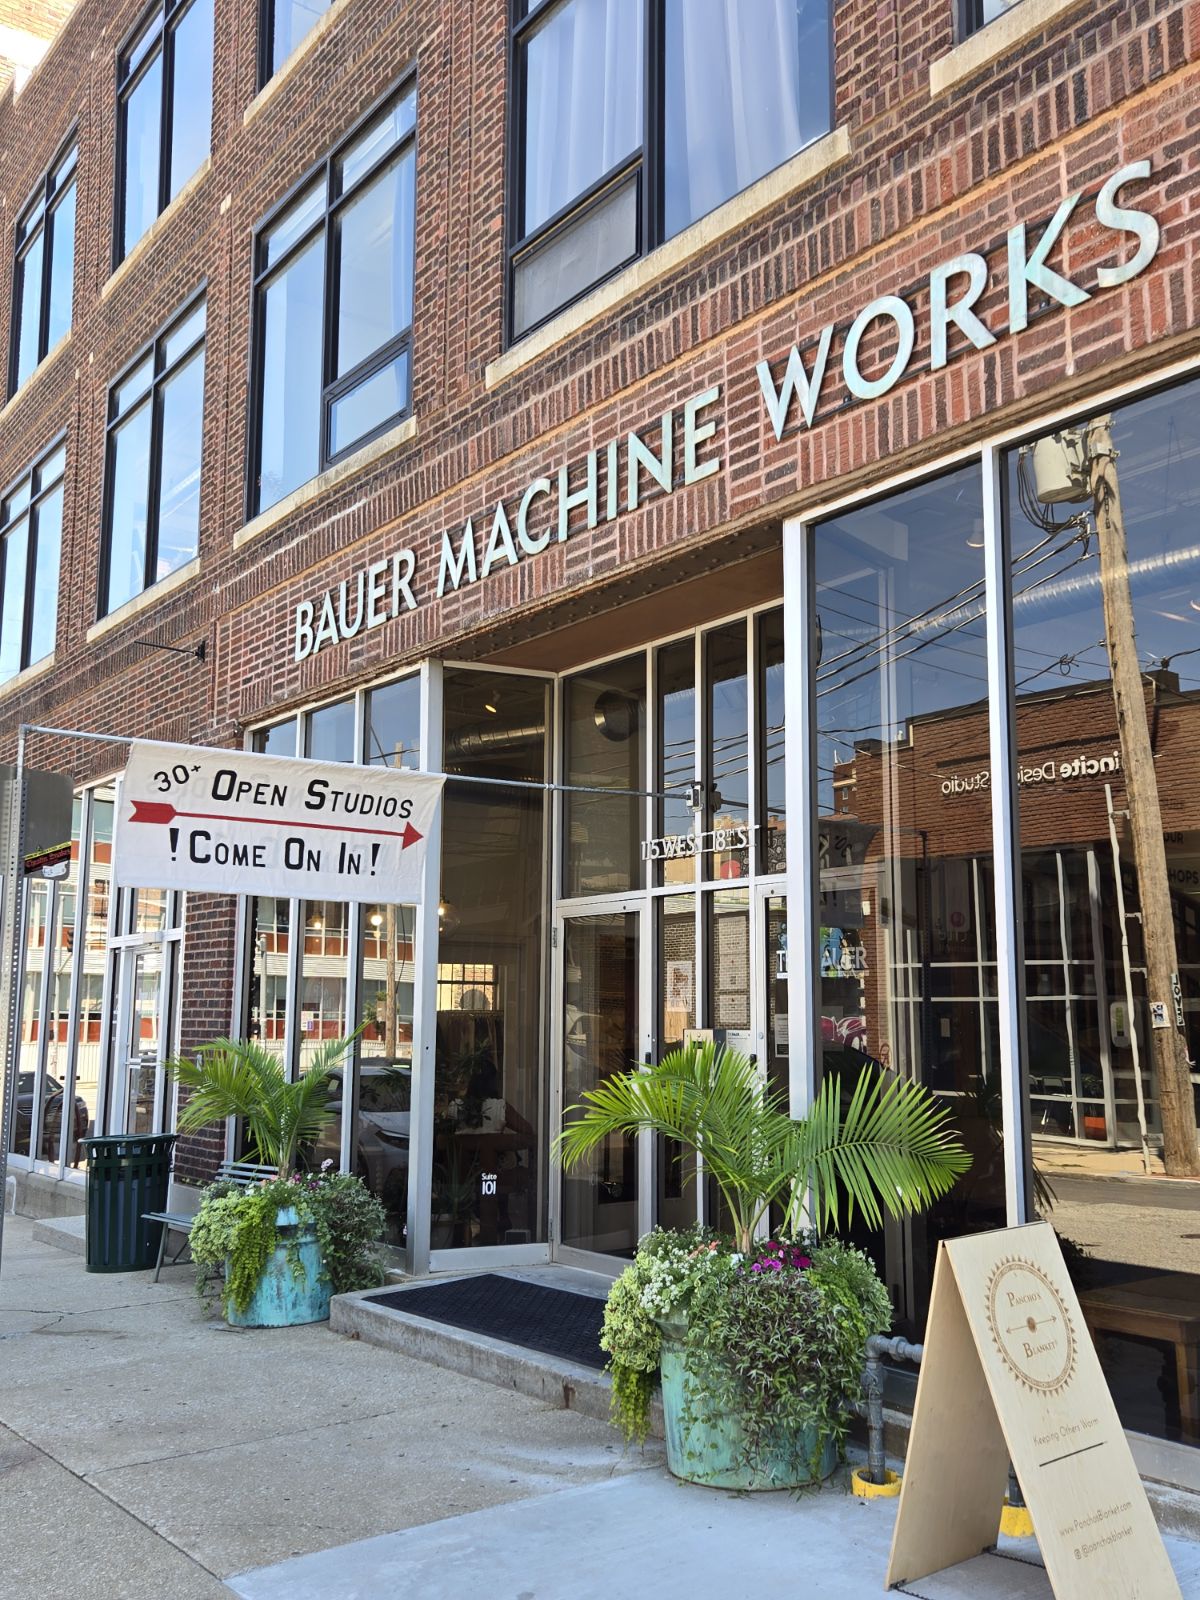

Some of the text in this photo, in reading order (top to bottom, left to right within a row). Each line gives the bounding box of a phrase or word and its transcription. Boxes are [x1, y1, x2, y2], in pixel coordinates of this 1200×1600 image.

[294, 160, 1161, 662] BAUER MACHINE WORKS
[211, 769, 288, 807] OPEN
[304, 779, 414, 819] STUDIOS
[284, 837, 321, 872] ON
[641, 838, 660, 860] 115
[481, 1172, 498, 1181] Suite
[482, 1180, 497, 1195] 101
[1032, 1431, 1060, 1447] Keeping
